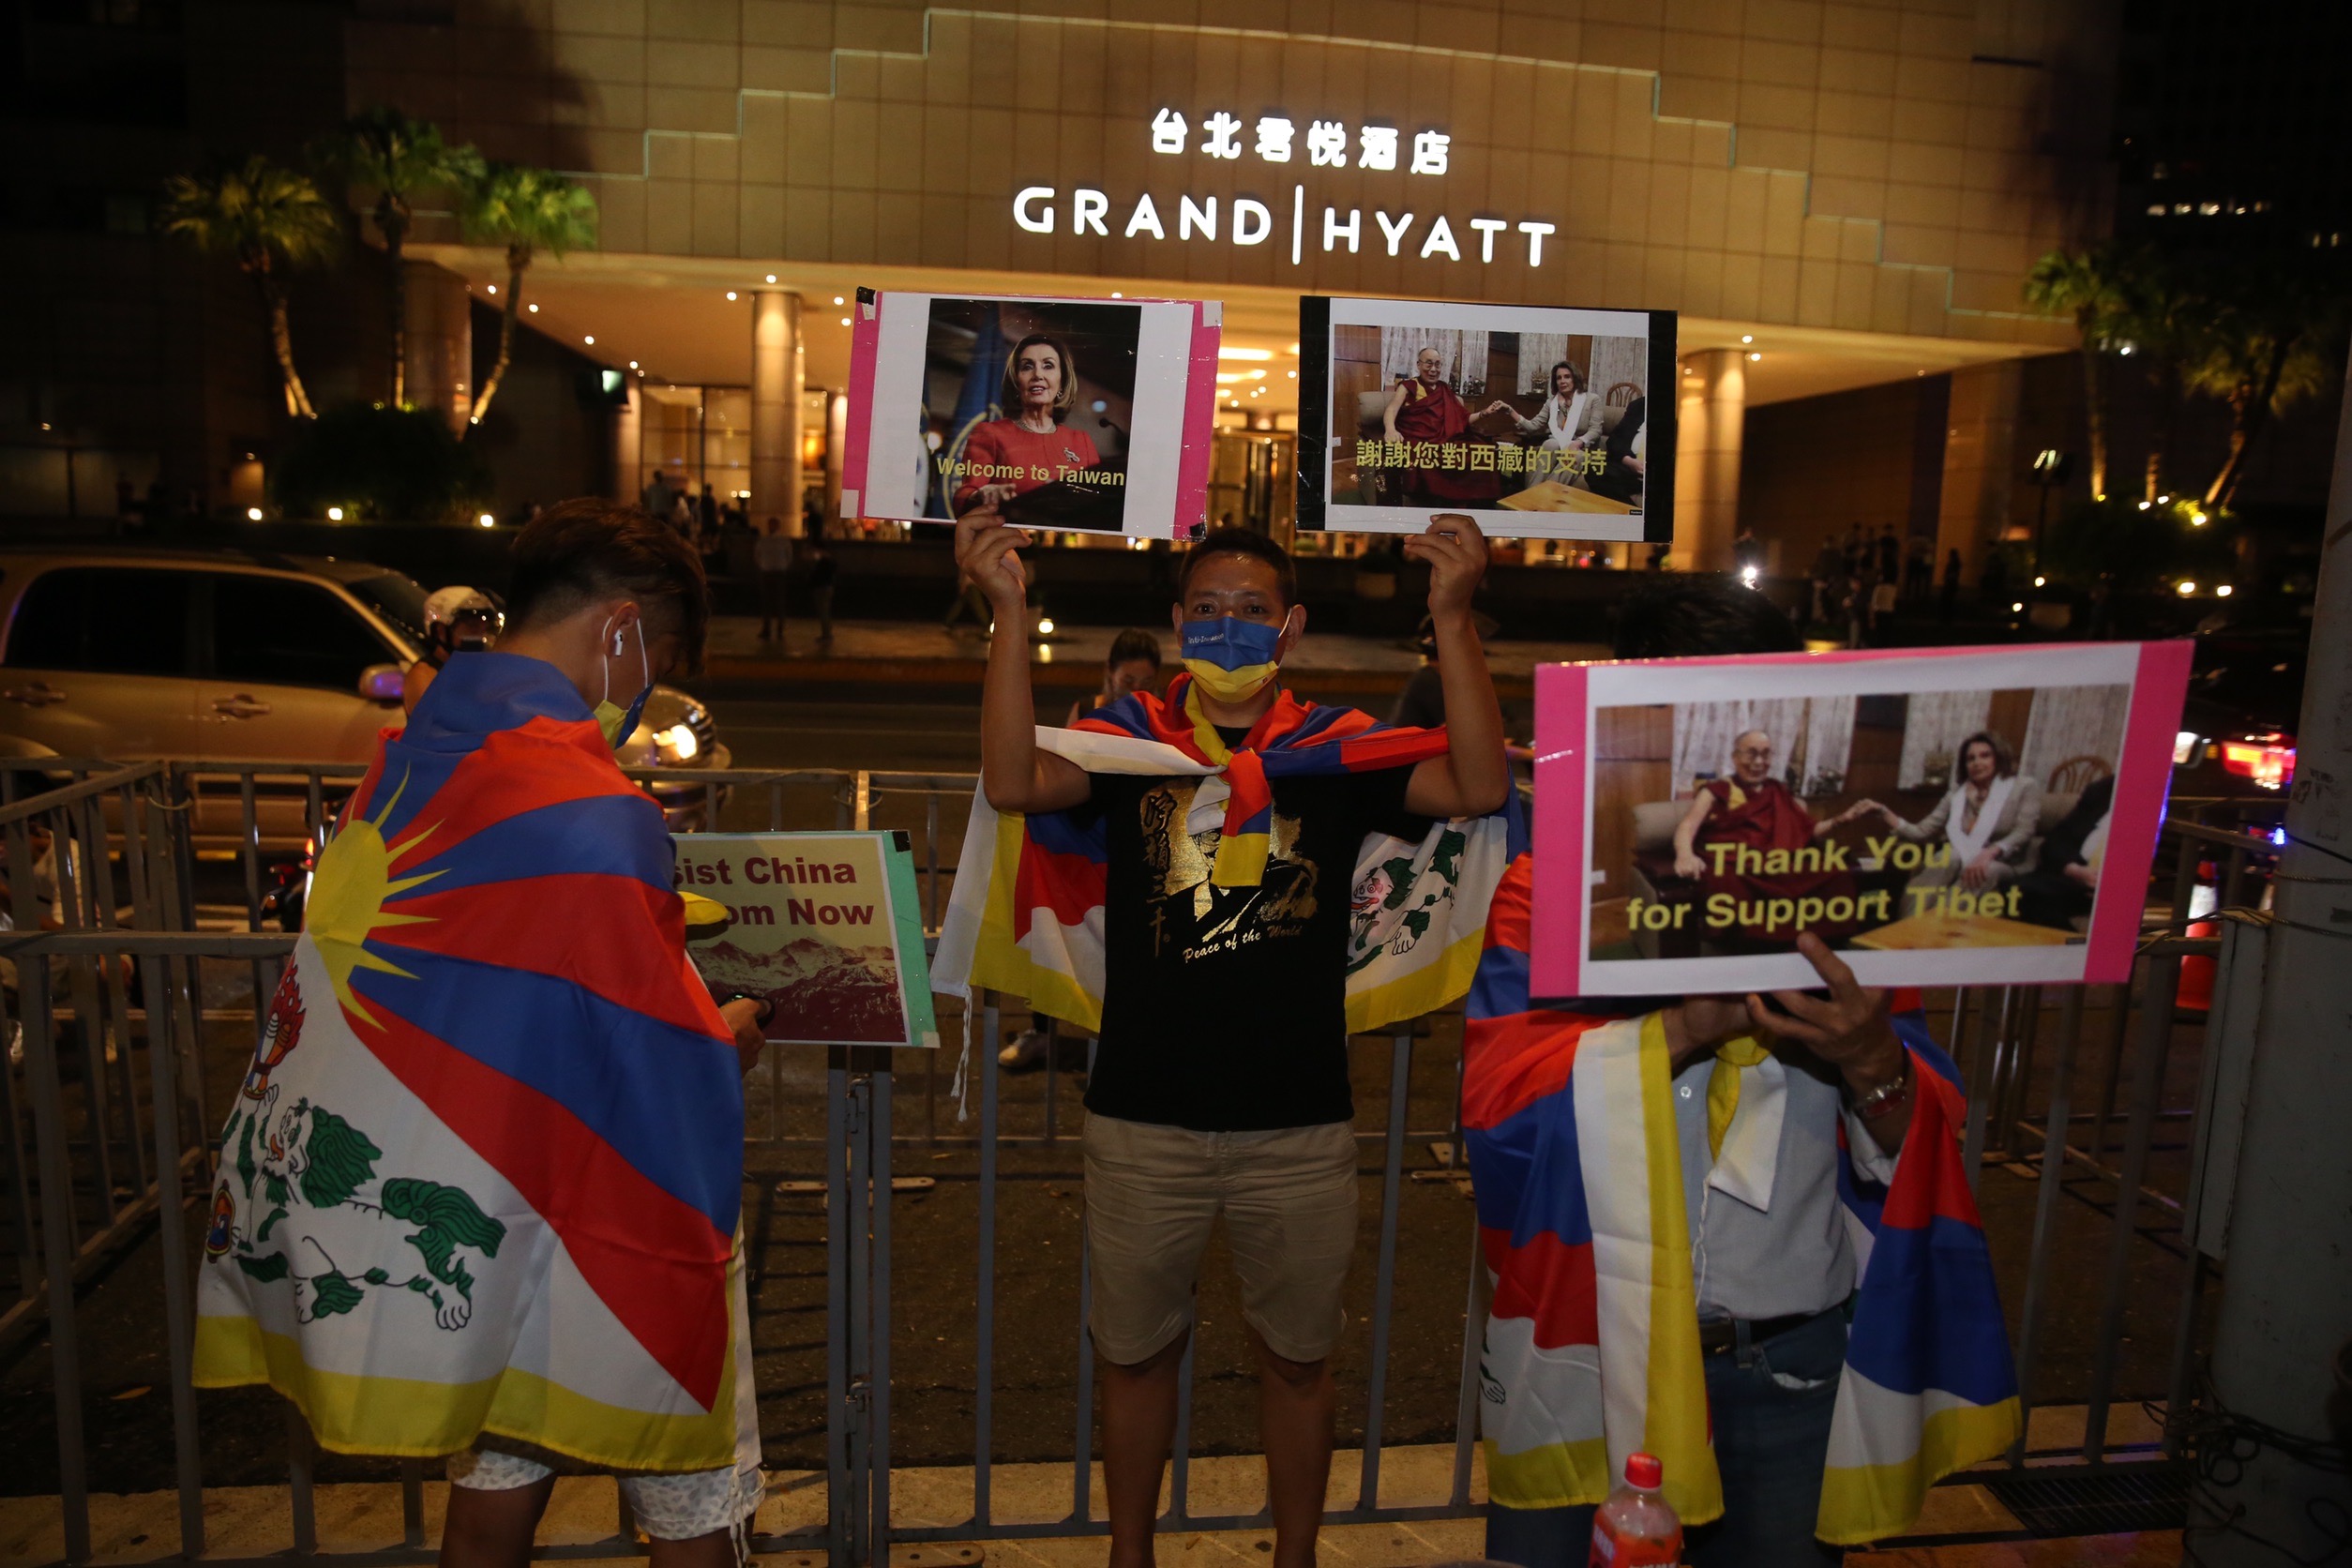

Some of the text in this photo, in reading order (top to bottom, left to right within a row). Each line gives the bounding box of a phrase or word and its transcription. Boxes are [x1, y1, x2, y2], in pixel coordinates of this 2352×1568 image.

[1013, 186, 1557, 268] GRAND HYATT
[936, 457, 1126, 487] Welcome to Taiwan
[1356, 439, 1607, 475] 謝謝您對西藏的支持
[745, 856, 857, 885] China
[1705, 834, 1953, 878] Thank You
[787, 897, 874, 926] Now
[1626, 883, 2024, 933] for Support Tibet
[1182, 942, 1221, 965] Peace
[1224, 932, 1238, 951] of
[1242, 927, 1261, 944] the
